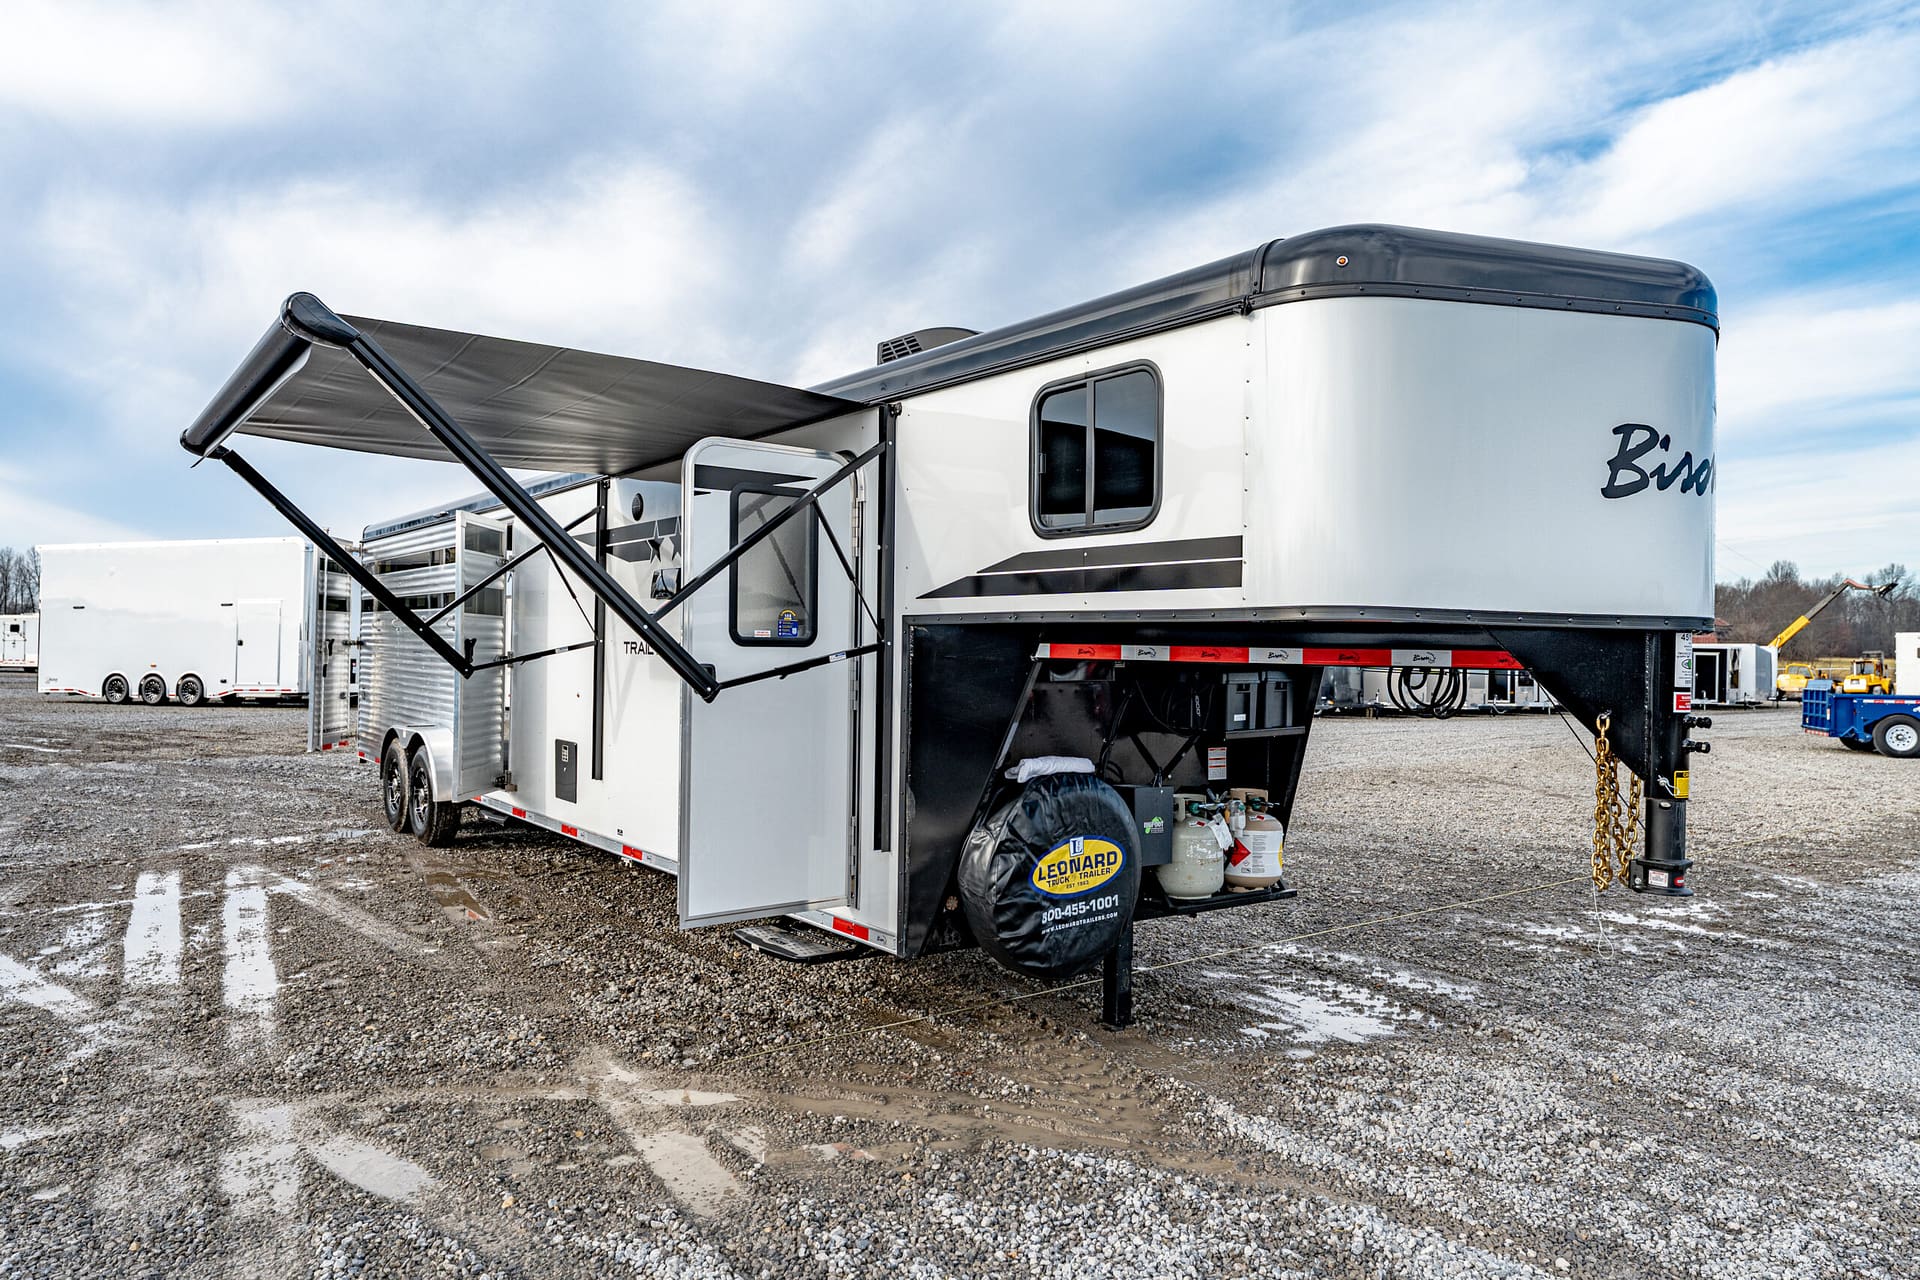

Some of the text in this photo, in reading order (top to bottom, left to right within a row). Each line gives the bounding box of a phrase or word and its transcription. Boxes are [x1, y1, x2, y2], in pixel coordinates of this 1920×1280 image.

[1037, 850, 1118, 882] LEONARD
[1046, 876, 1070, 888] TRUCK
[1079, 867, 1111, 880] TRAILER
